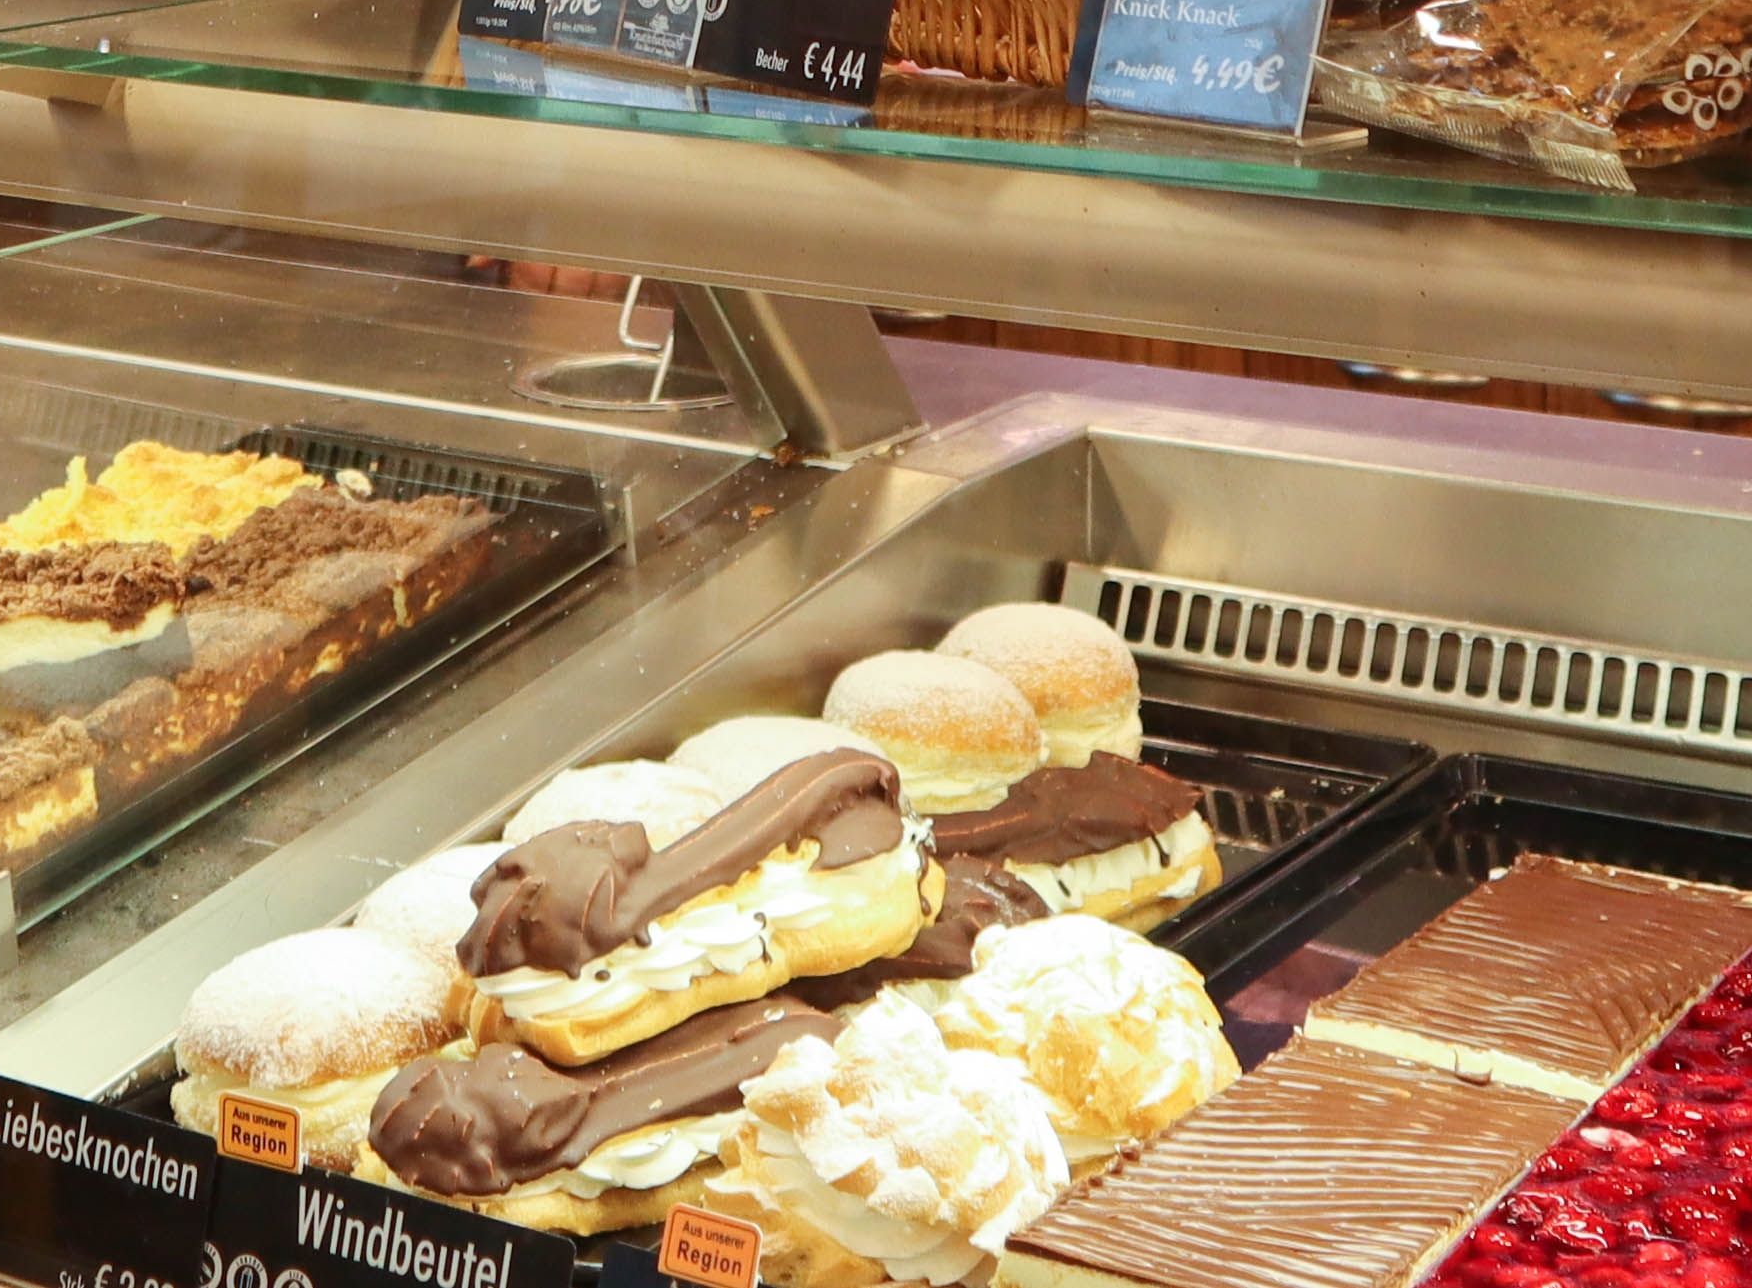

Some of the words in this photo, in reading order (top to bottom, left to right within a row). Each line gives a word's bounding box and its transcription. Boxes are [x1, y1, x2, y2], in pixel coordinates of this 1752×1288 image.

[1176, 0, 1241, 28] Knack
[755, 46, 789, 74] Becher
[803, 41, 820, 79] €
[820, 49, 867, 91] 4,44
[1191, 54, 1285, 95] 4,49€
[232, 1105, 250, 1123] Aus
[252, 1114, 287, 1131] unserer
[230, 1124, 288, 1156] Region
[296, 1185, 513, 1288] Windbeutel
[682, 1220, 703, 1238] Aus
[704, 1229, 745, 1249] unserer
[677, 1239, 743, 1278] Region
